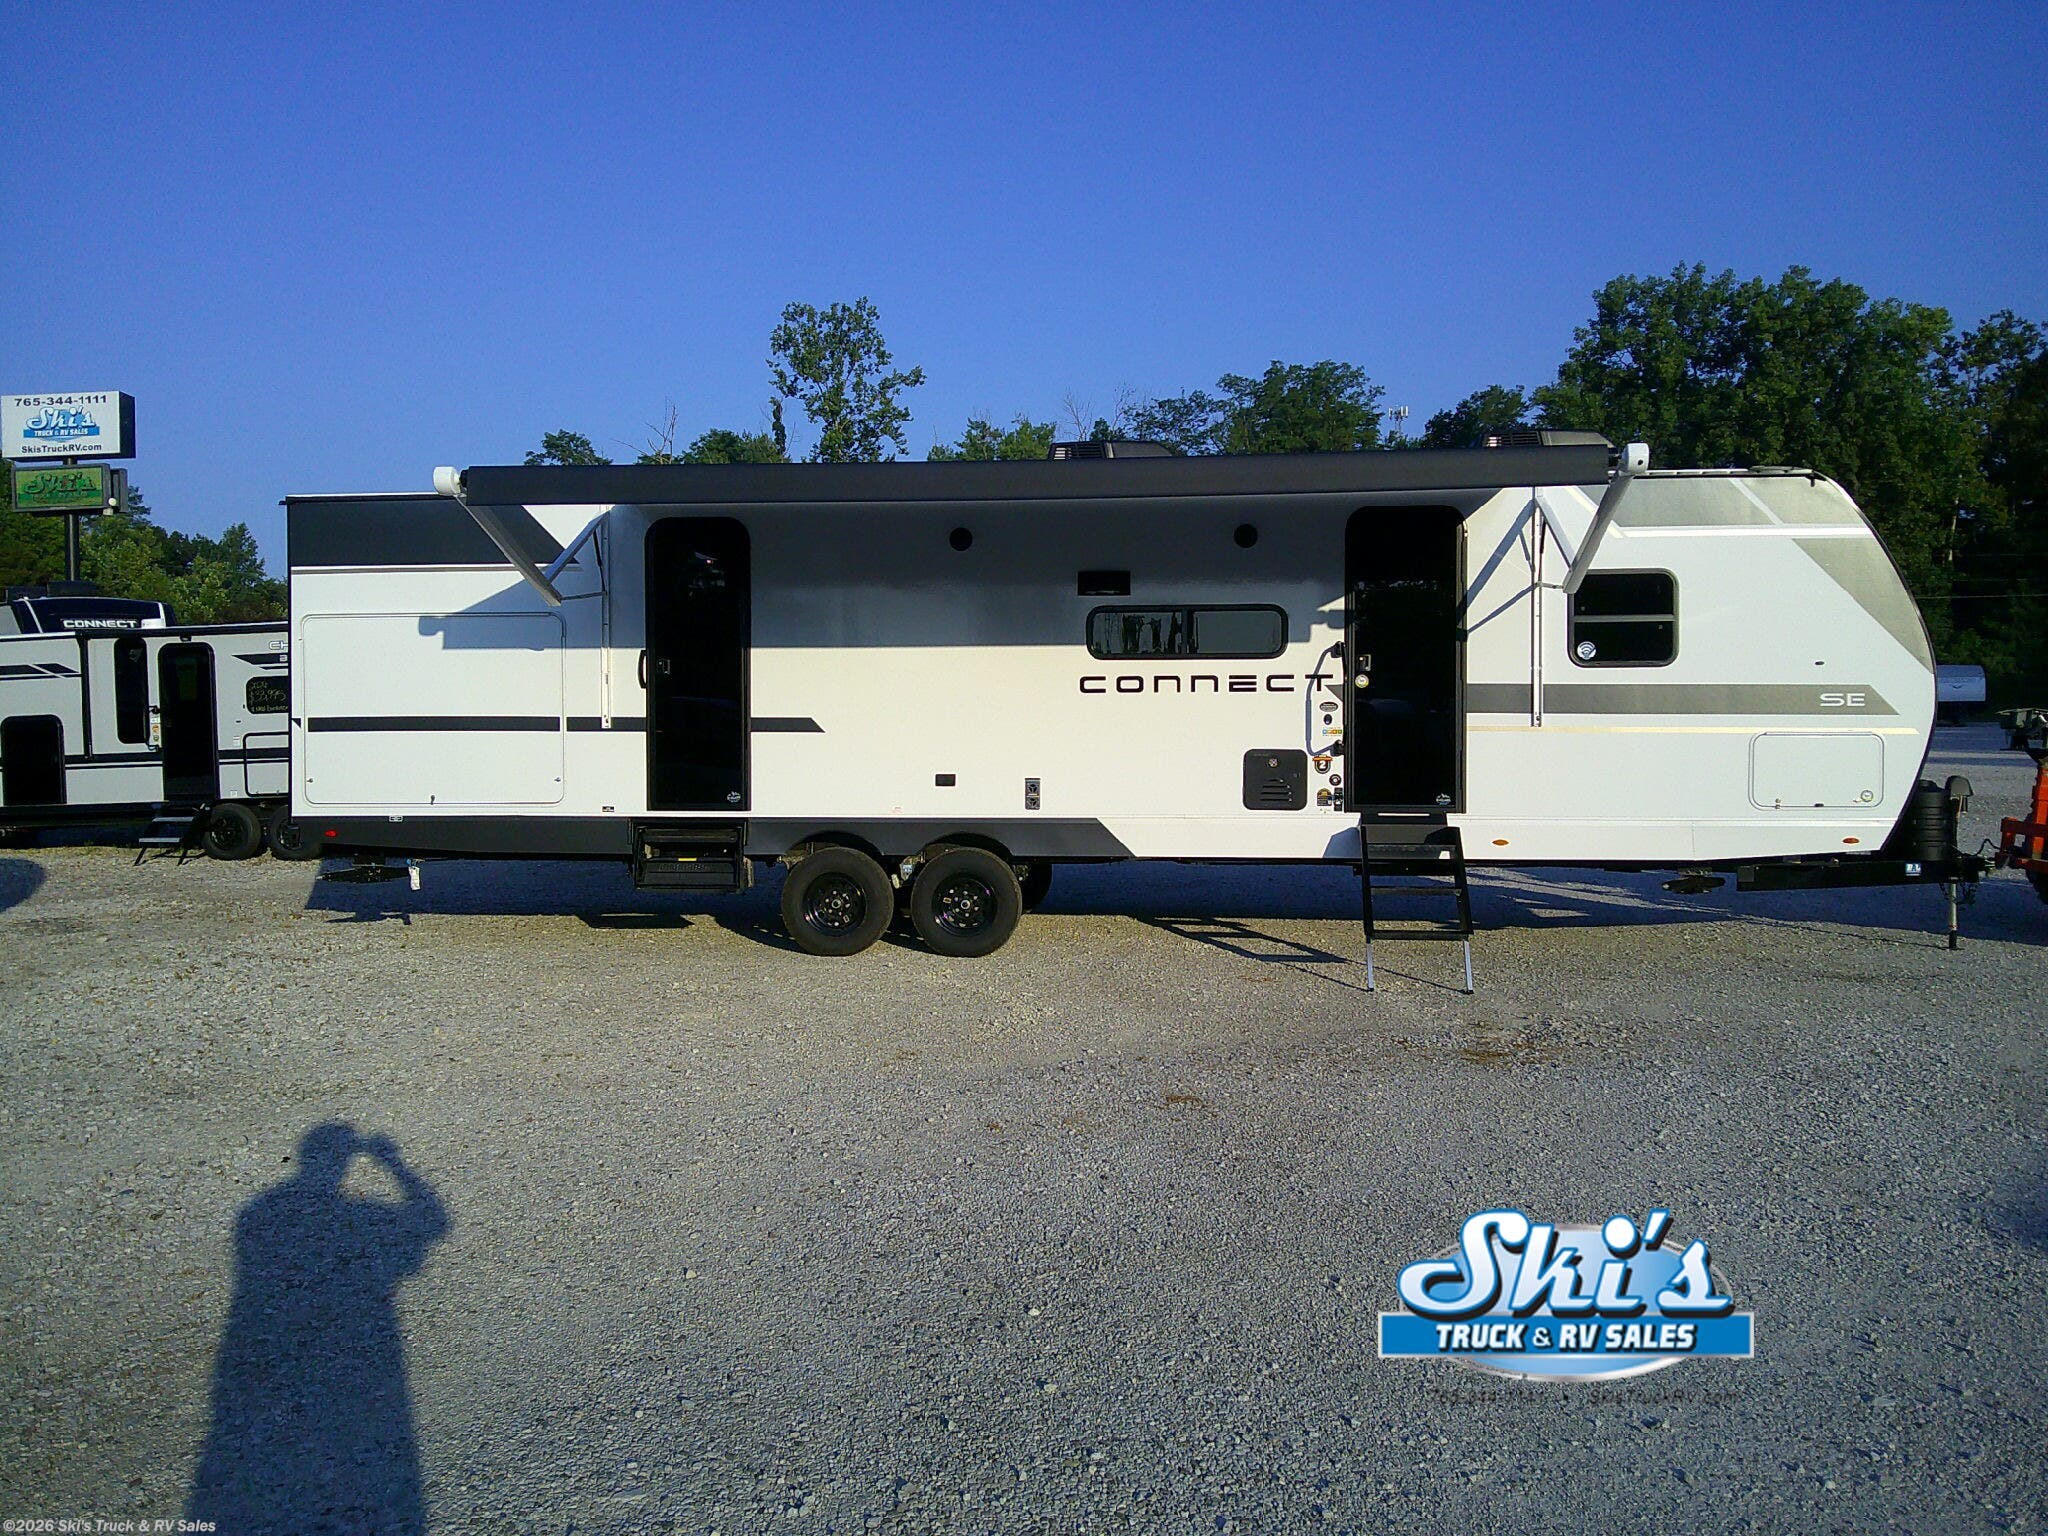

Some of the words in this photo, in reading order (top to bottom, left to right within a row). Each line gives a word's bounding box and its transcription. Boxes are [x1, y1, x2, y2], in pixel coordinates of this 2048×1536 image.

[14, 395, 107, 406] 765-344-1111
[26, 405, 97, 430] Ski's
[21, 444, 102, 453] SkisTruckRV.com
[63, 619, 137, 628] CONNECT
[1079, 674, 1334, 693] CONNECT
[1819, 693, 1866, 707] SE
